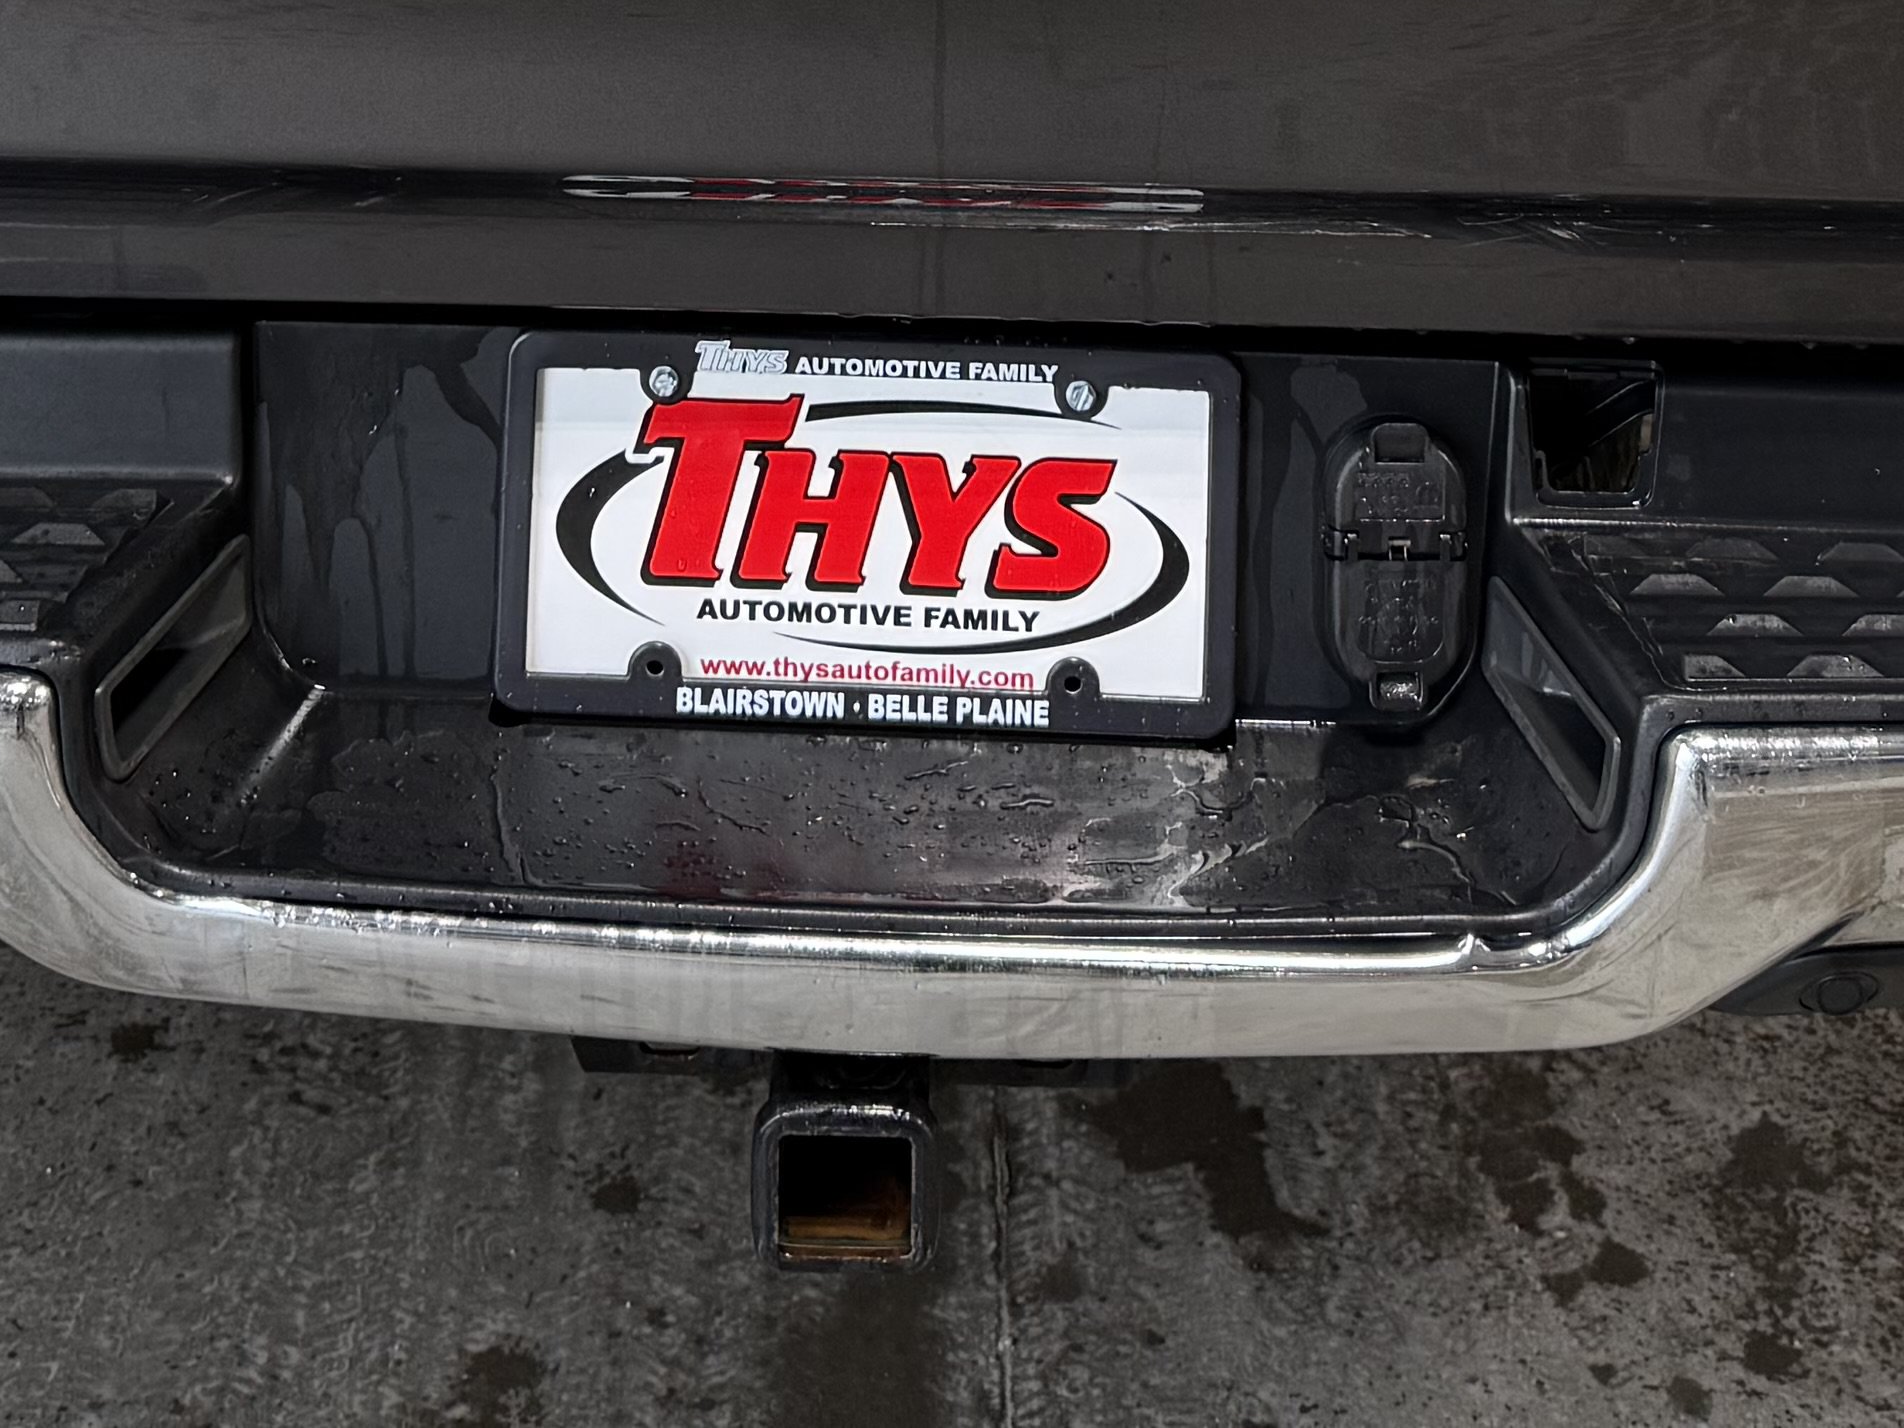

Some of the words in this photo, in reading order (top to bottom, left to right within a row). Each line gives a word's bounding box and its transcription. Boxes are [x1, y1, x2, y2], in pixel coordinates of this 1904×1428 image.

[795, 356, 961, 380] AUTOMOTIVE
[968, 361, 1059, 383] FAMILY
[633, 393, 1117, 599] THYS
[696, 597, 912, 628] AUTOMOTIVE
[923, 606, 1041, 633] FAMILY
[700, 656, 1035, 691] www.thysautofamily.com
[675, 686, 846, 721] BLAIRSTOWN
[867, 693, 949, 723] BELLE
[955, 696, 1050, 728] PLAINE
